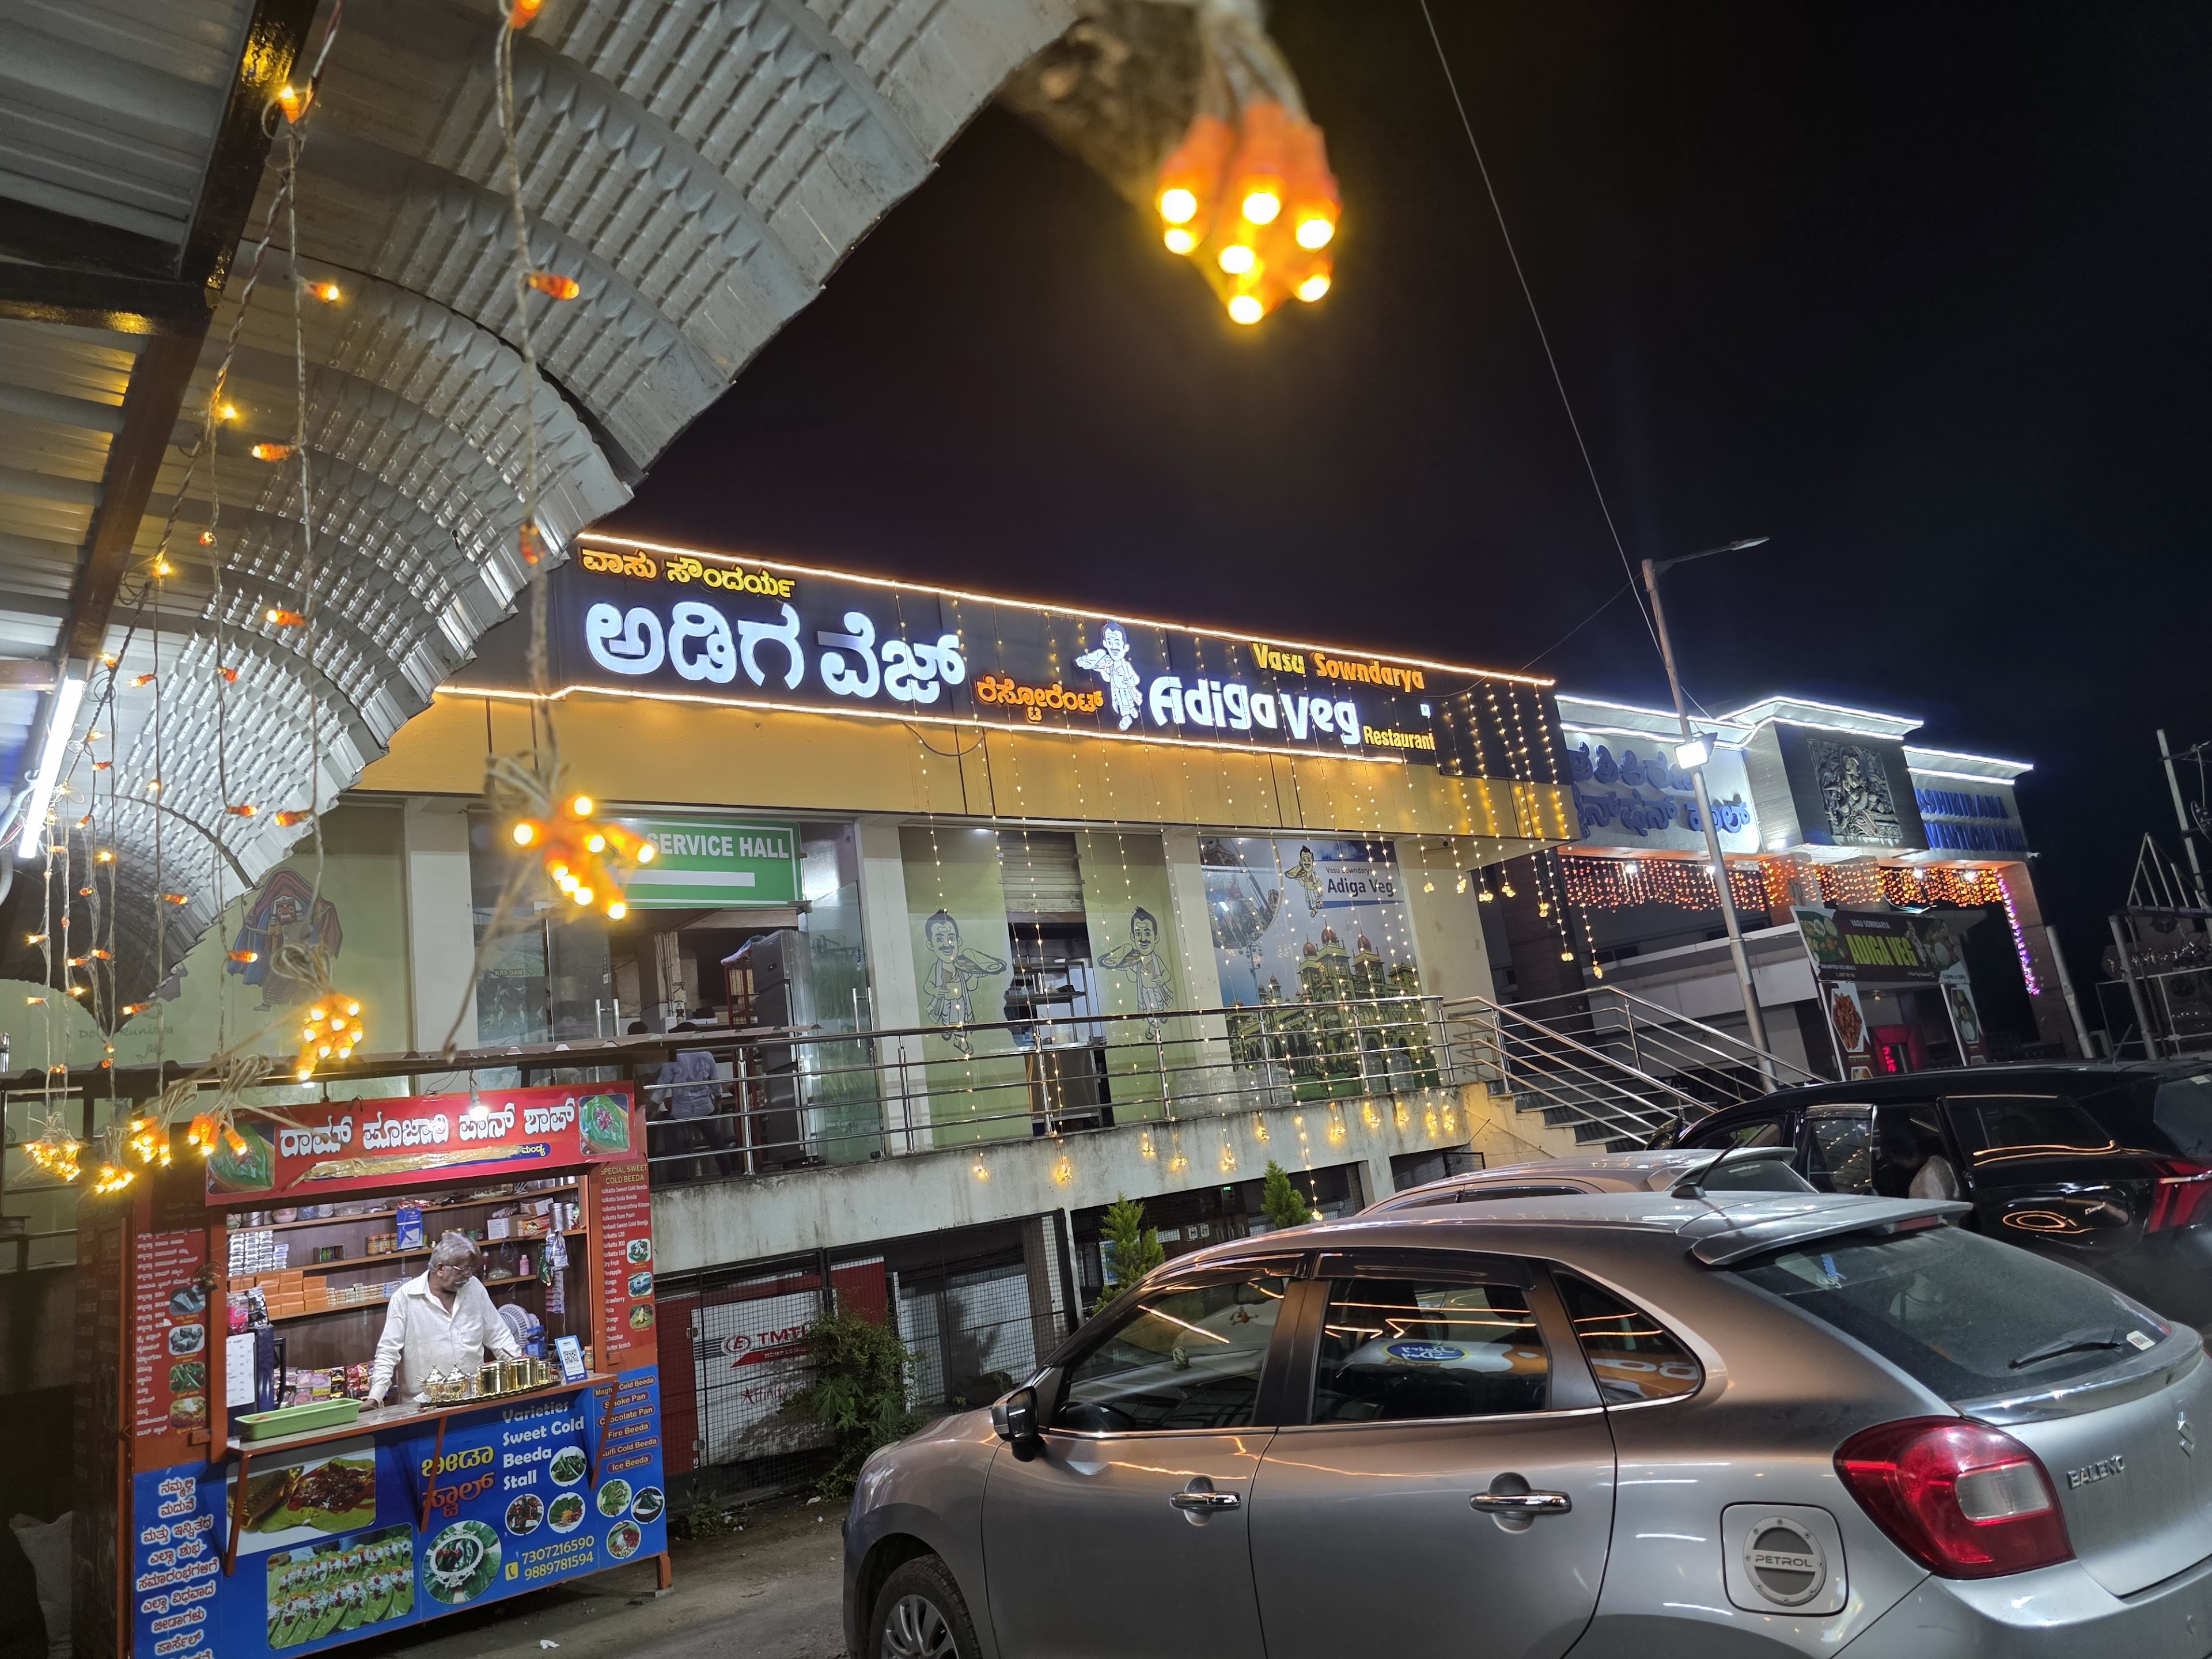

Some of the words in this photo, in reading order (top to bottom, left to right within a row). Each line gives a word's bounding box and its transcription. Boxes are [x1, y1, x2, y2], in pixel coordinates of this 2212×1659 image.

[582, 548, 657, 579] ವಾಸು
[666, 556, 796, 599] ಸೌಂದರ್ಯ
[585, 601, 805, 690] ಅಡಿಗ
[816, 611, 965, 704] ವೆಜ್
[1252, 642, 1306, 675] Vasu
[1315, 652, 1425, 693] Sowndarya
[1149, 676, 1278, 732] Adiga
[1364, 725, 1435, 751] Restaurant
[646, 832, 734, 857] SERVICE
[739, 837, 789, 858] HALL
[1328, 878, 1366, 897] Adiga
[1369, 879, 1395, 897] Veg
[1845, 934, 1895, 966] ADIGA
[1885, 935, 1919, 966] VEG
[524, 1097, 575, 1134] ಶಾಪ್
[600, 1166, 626, 1175] SPECIAL
[627, 1164, 648, 1173] SWEET
[605, 1176, 623, 1185] COLD
[624, 1174, 645, 1183] BEEDA
[618, 1342, 631, 1350] Scotch
[595, 1387, 613, 1396] Magh
[619, 1381, 633, 1390] Cold
[634, 1377, 654, 1387] Beeda
[741, 1387, 789, 1404] Affinity
[631, 1393, 646, 1402] Pan
[502, 1400, 569, 1424] Varieties
[600, 1411, 637, 1425] Cocolate
[639, 1407, 653, 1415] Pan
[502, 1428, 547, 1447] Sweet
[551, 1416, 584, 1435] Cold
[608, 1430, 623, 1439] Fire
[624, 1424, 649, 1434] Beeda
[618, 1444, 634, 1453] Cold
[635, 1438, 657, 1448] Beeda
[503, 1446, 552, 1468] Beeda
[612, 1463, 624, 1471] Ice
[626, 1457, 649, 1467] Beeda
[503, 1470, 537, 1491] Stall
[2067, 1456, 2126, 1490] BALENO
[161, 1478, 195, 1497] ನಮ್ಮಲ್ಲಿ
[161, 1498, 195, 1516] ಮದುವೆ
[143, 1528, 169, 1543] ಮತ್ತು
[522, 1535, 595, 1563] 7307216590
[524, 1552, 594, 1581] 9889781594
[1755, 1553, 1813, 1568] PETROL
